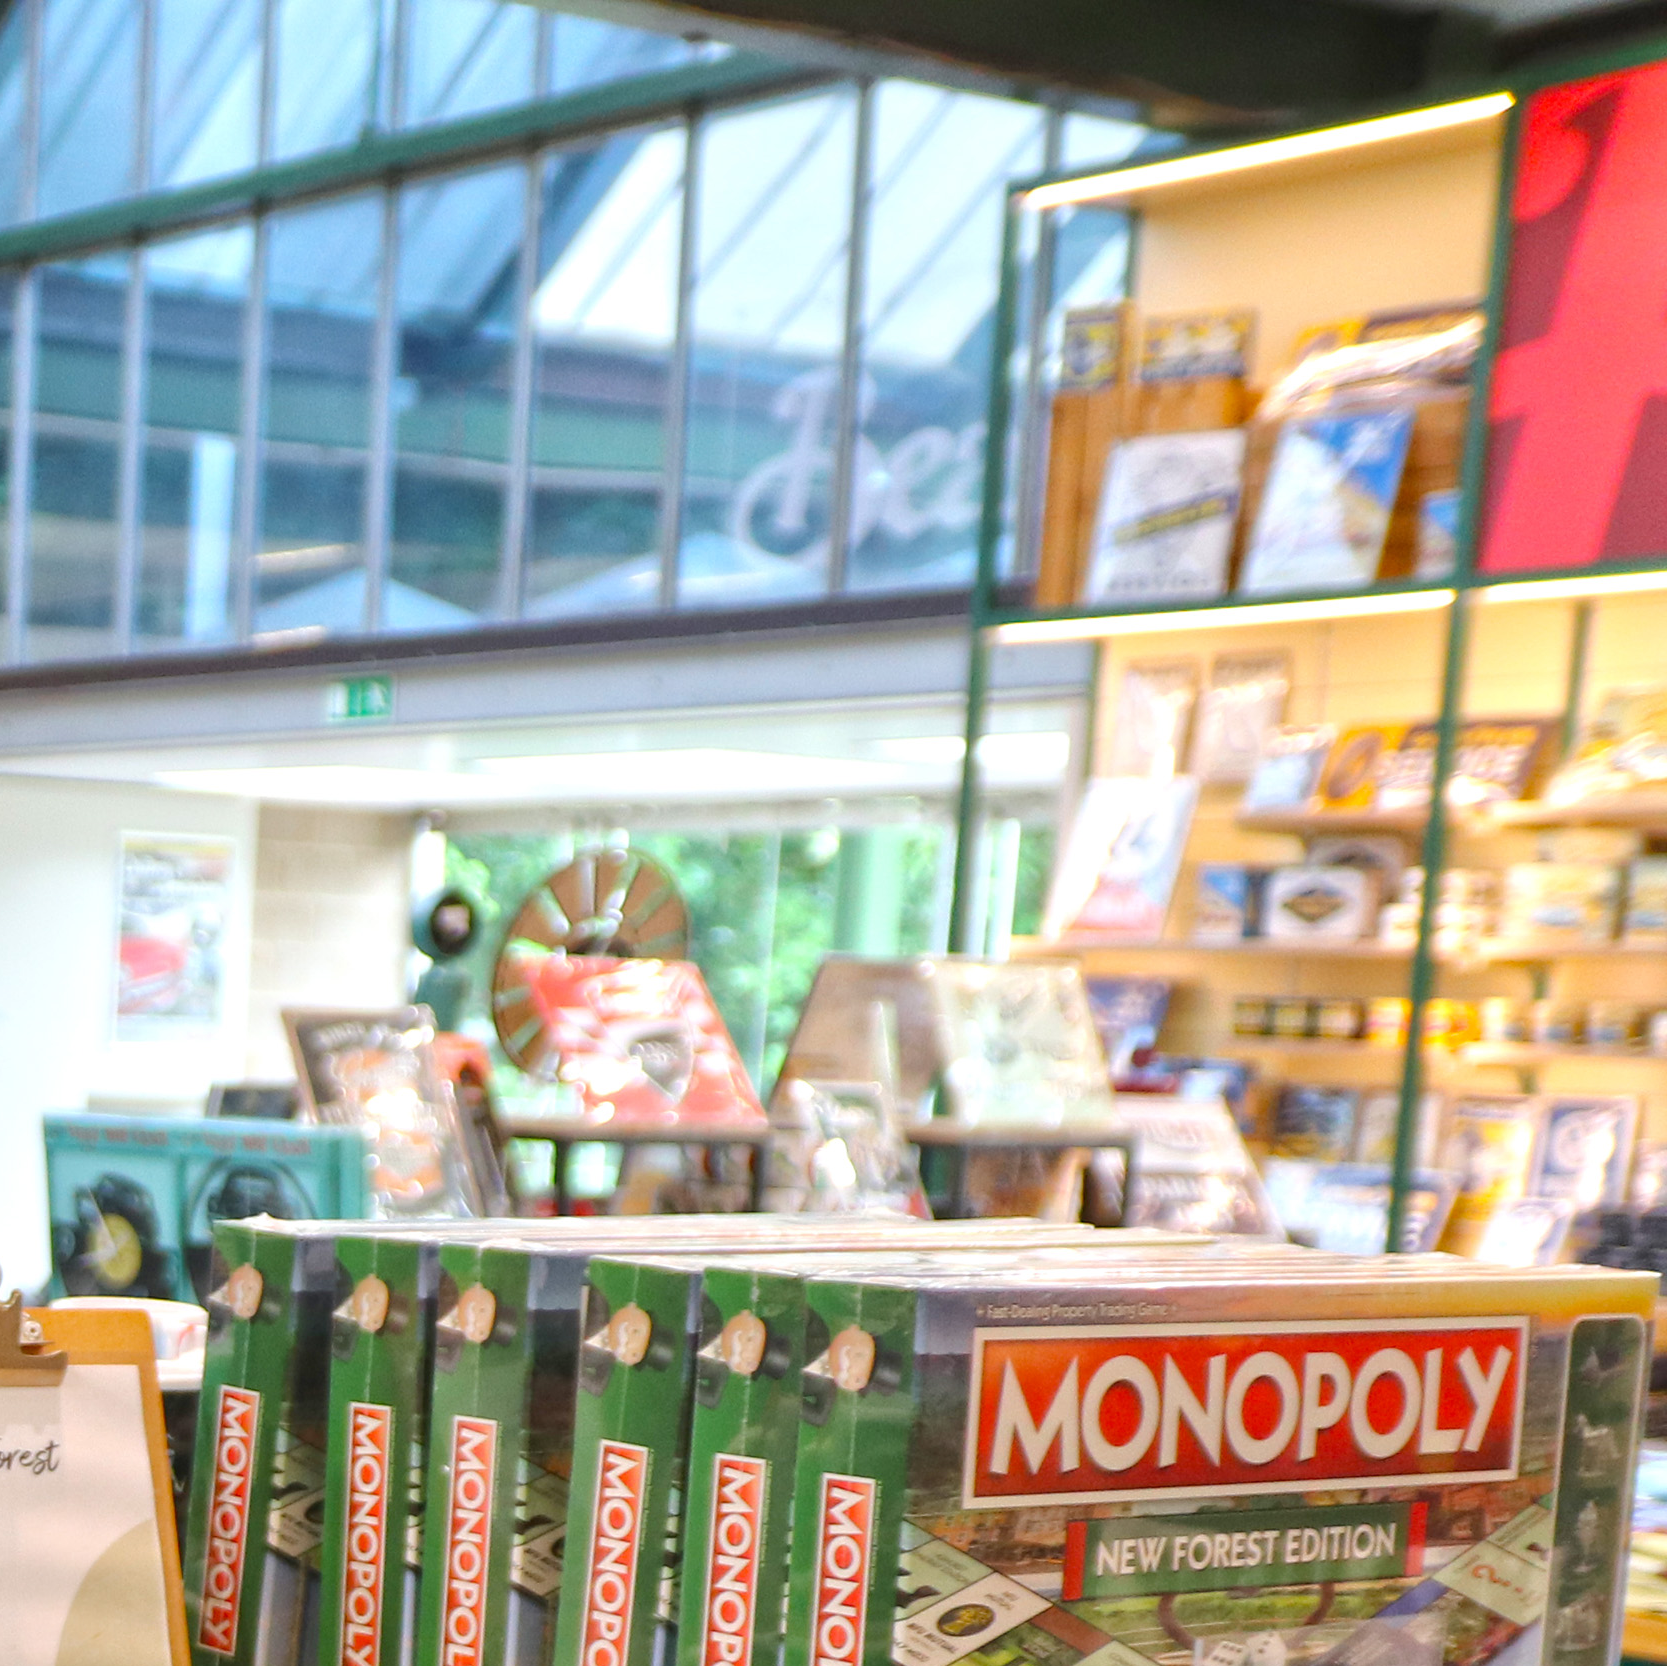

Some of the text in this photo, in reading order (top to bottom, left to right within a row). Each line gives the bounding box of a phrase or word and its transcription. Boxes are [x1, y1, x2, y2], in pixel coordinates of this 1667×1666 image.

[989, 1345, 1513, 1476] MONOPOLY
[202, 1397, 256, 1649] MONOPOLY
[1096, 1523, 1396, 1576] NEW FOREST EDITION
